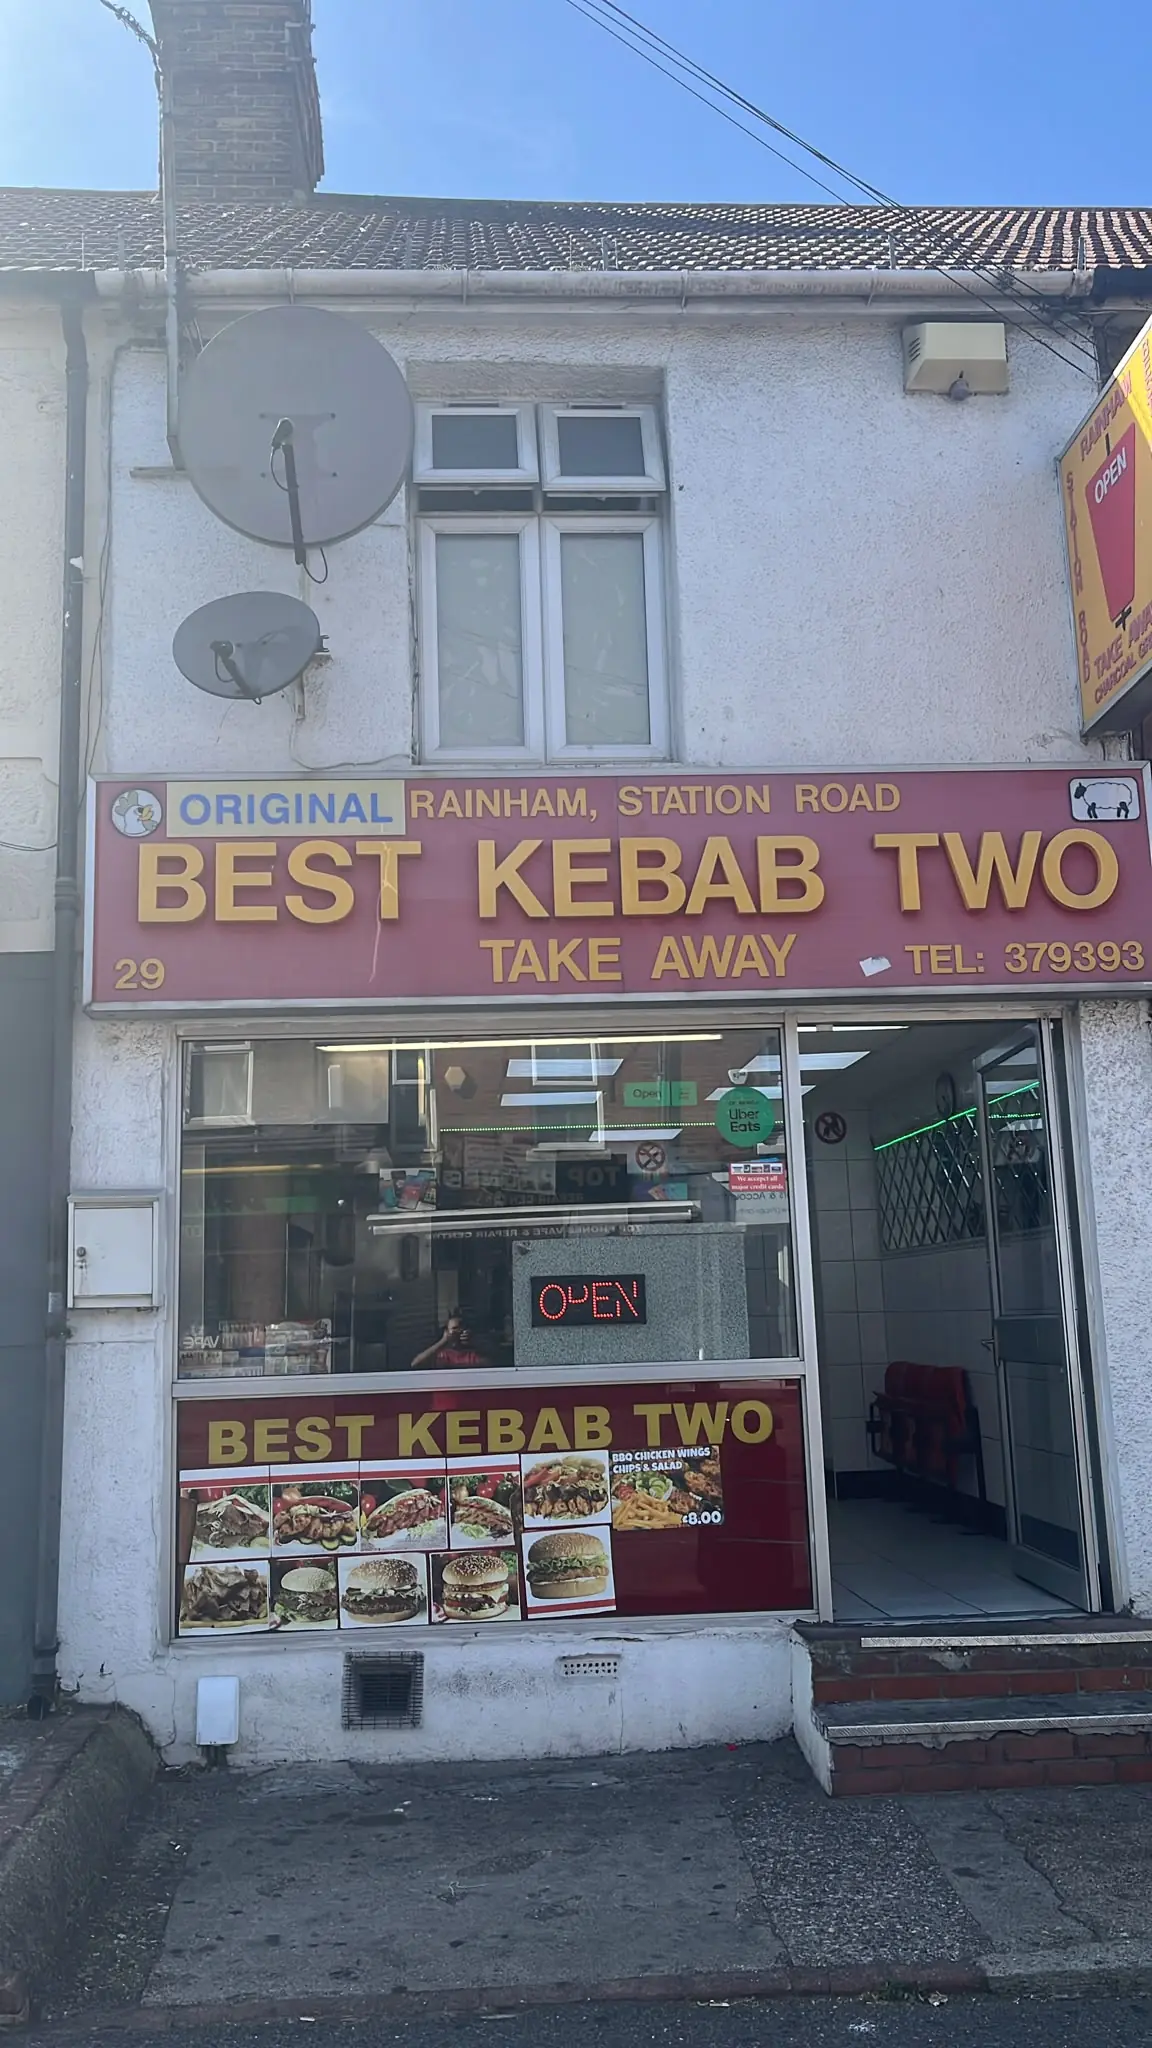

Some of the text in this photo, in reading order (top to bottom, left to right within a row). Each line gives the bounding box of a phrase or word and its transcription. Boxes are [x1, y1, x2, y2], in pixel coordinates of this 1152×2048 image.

[1094, 447, 1128, 504] OPEN
[1093, 632, 1123, 680] TAKE
[179, 783, 900, 826] ORIGINAL RAINHAM, STATION ROAD
[137, 827, 1120, 925] BEST KEBAB TWO
[114, 933, 797, 991] 29 TAKE AWAY
[904, 940, 1146, 975] TEL: 379393
[632, 1088, 662, 1100] Open
[728, 1107, 760, 1120] Uber
[729, 1121, 761, 1133] Eats
[207, 1399, 774, 1465] BEST KEBAB TWO
[612, 1447, 711, 1463] BBQ CHICKEN WINGS
[613, 1461, 683, 1474] CHIPS & SALAD
[682, 1510, 722, 1525] £8.00
